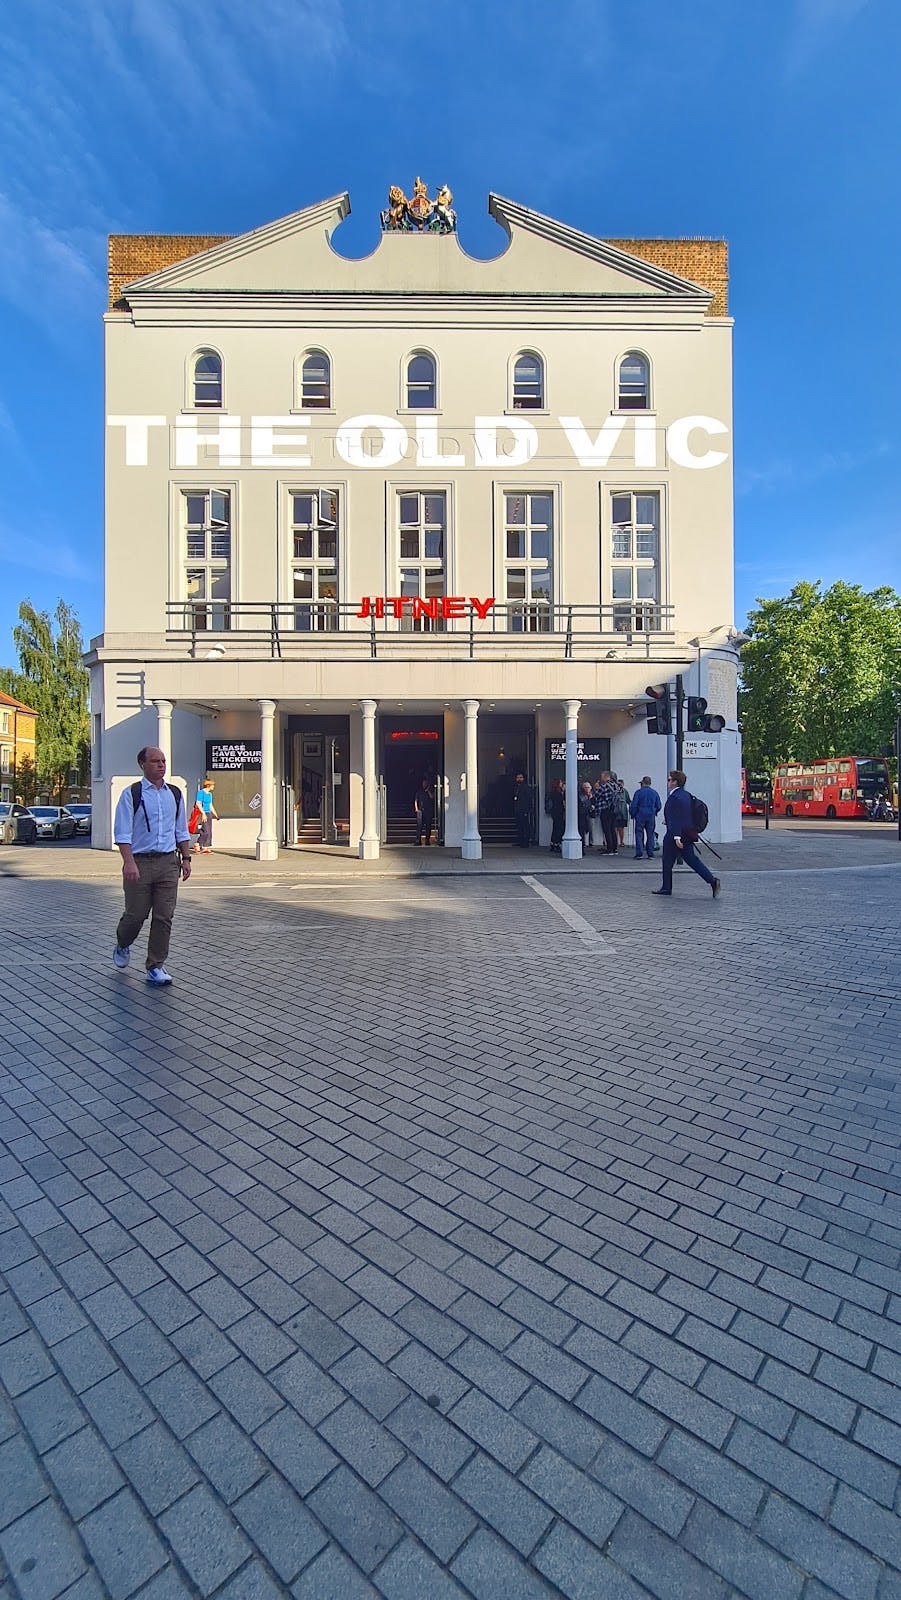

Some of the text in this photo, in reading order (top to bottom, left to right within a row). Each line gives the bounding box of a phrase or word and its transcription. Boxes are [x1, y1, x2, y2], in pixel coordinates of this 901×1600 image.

[107, 414, 729, 469] THE OLD VIC
[323, 436, 386, 458] THE
[399, 436, 461, 459] OLD
[357, 596, 496, 619] JITNEY
